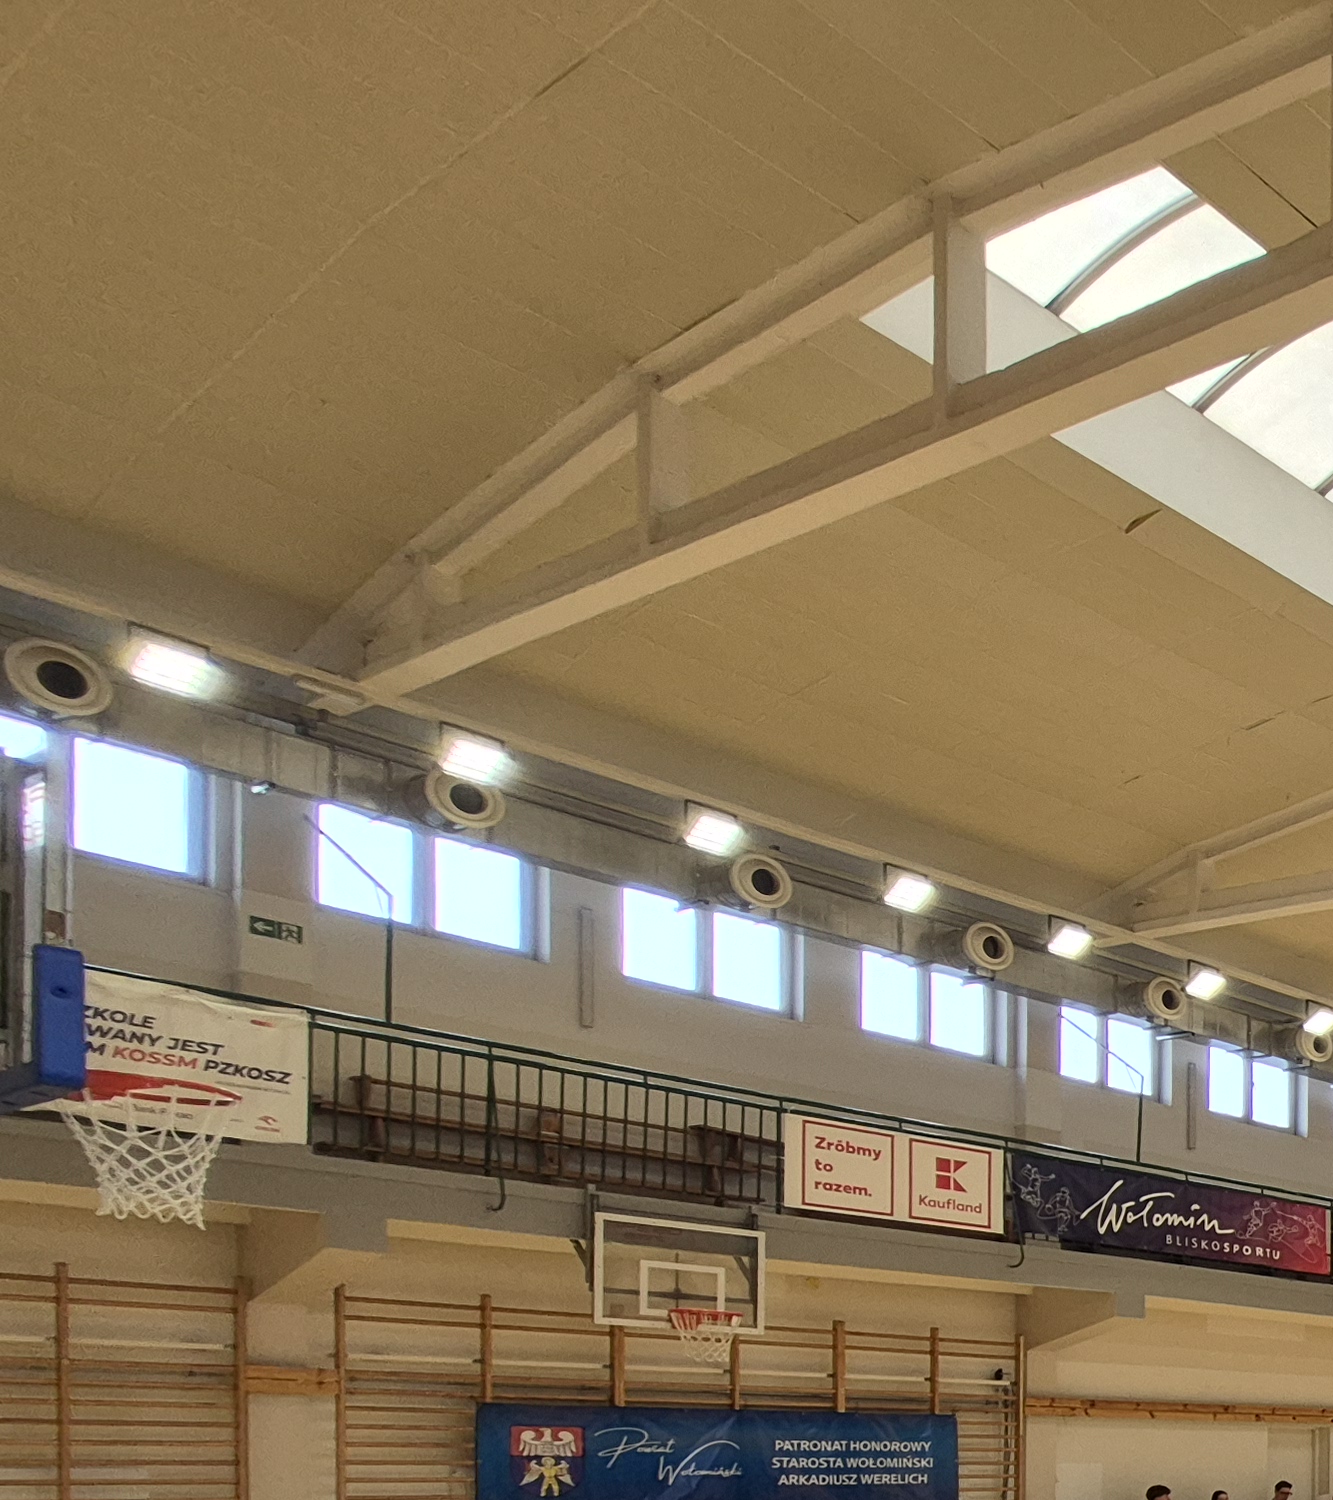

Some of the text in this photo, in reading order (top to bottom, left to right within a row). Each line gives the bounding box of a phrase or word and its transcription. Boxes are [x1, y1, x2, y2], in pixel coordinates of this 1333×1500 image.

[167, 1038, 225, 1056] JEST
[112, 1045, 199, 1069] KOSSM
[203, 1059, 293, 1085] PZKOSZ
[814, 1136, 882, 1161] Zróbmy
[814, 1158, 834, 1173] to
[814, 1180, 873, 1197] razem.
[918, 1194, 983, 1214] Kaufland
[1165, 1234, 1281, 1260] BLISKOSPORTU
[774, 1440, 932, 1452] PATRONAT HONOROWY
[771, 1455, 934, 1469] STAROSTA WOŁOMIŃSKI
[777, 1473, 928, 1486] ARKADIUSZ WERELICH
